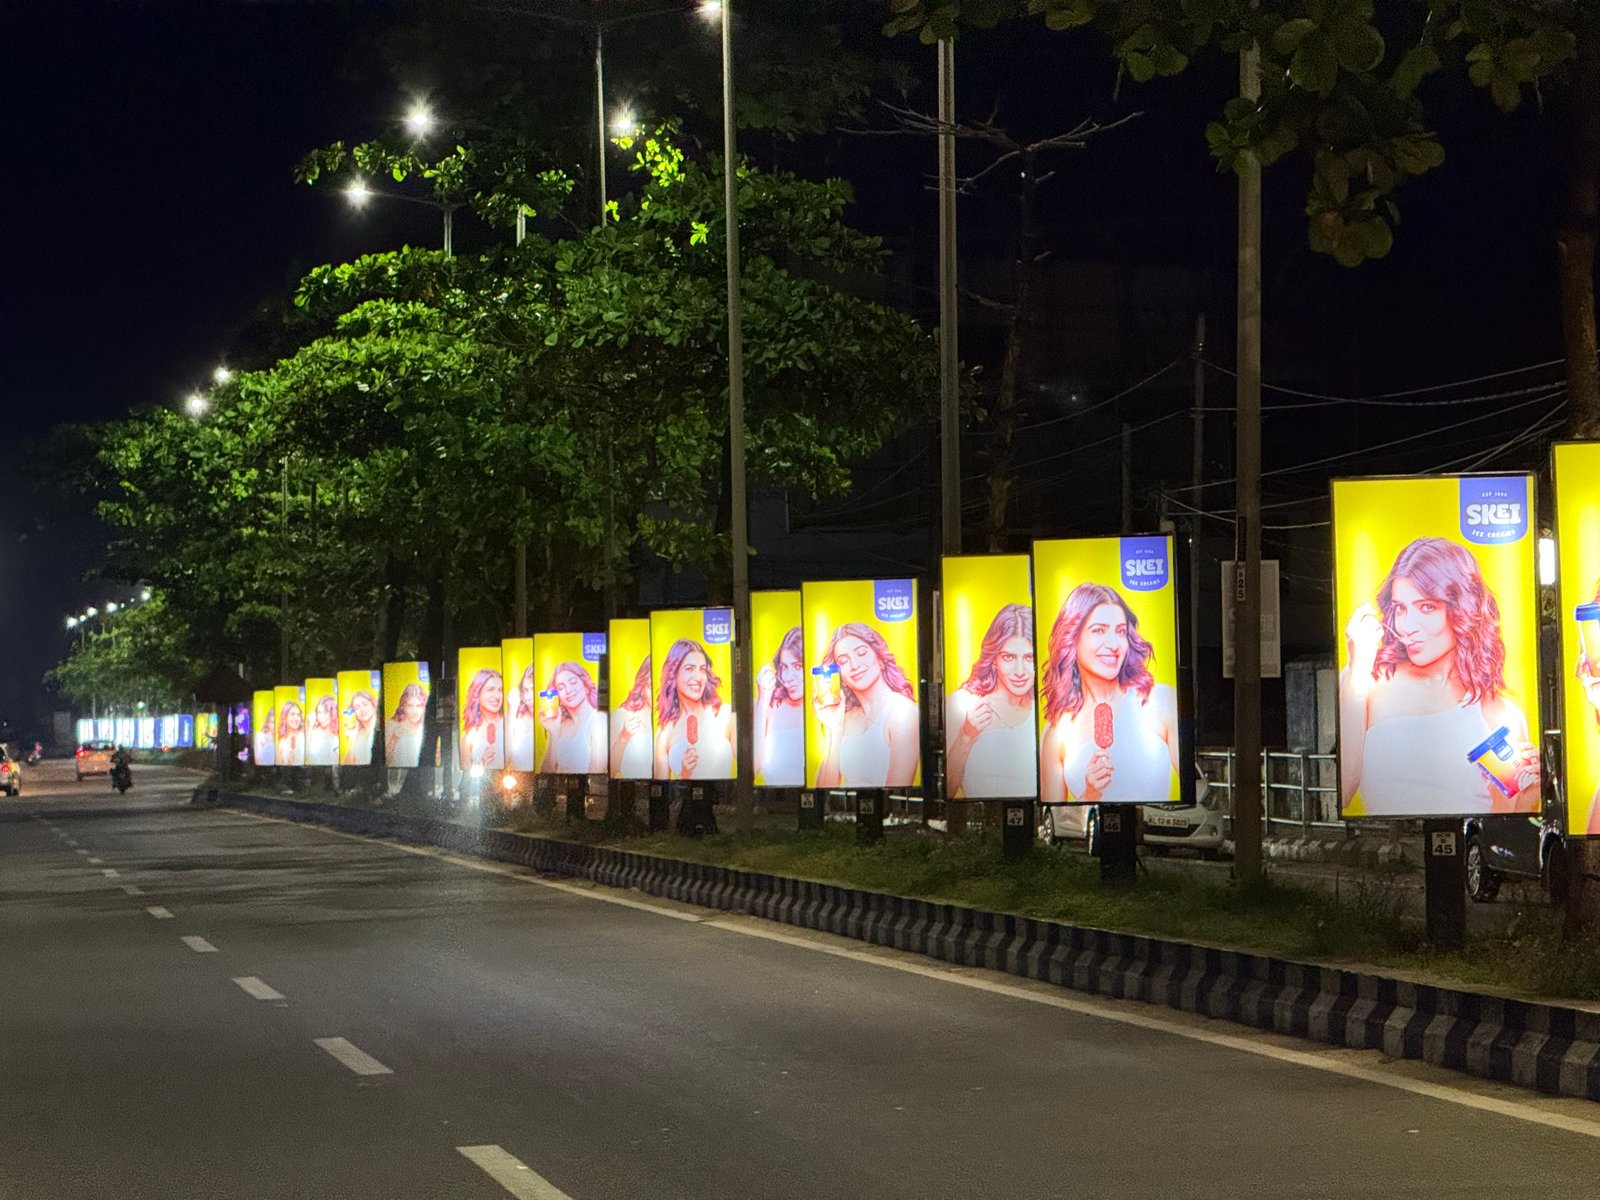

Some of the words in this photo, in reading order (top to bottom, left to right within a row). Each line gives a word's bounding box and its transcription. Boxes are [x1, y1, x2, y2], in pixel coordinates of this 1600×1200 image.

[1466, 503, 1521, 525] SKEI
[1125, 558, 1164, 577] SKEI
[878, 596, 910, 611] SKEI
[705, 623, 730, 635] SKEI
[1434, 844, 1453, 854] 45
